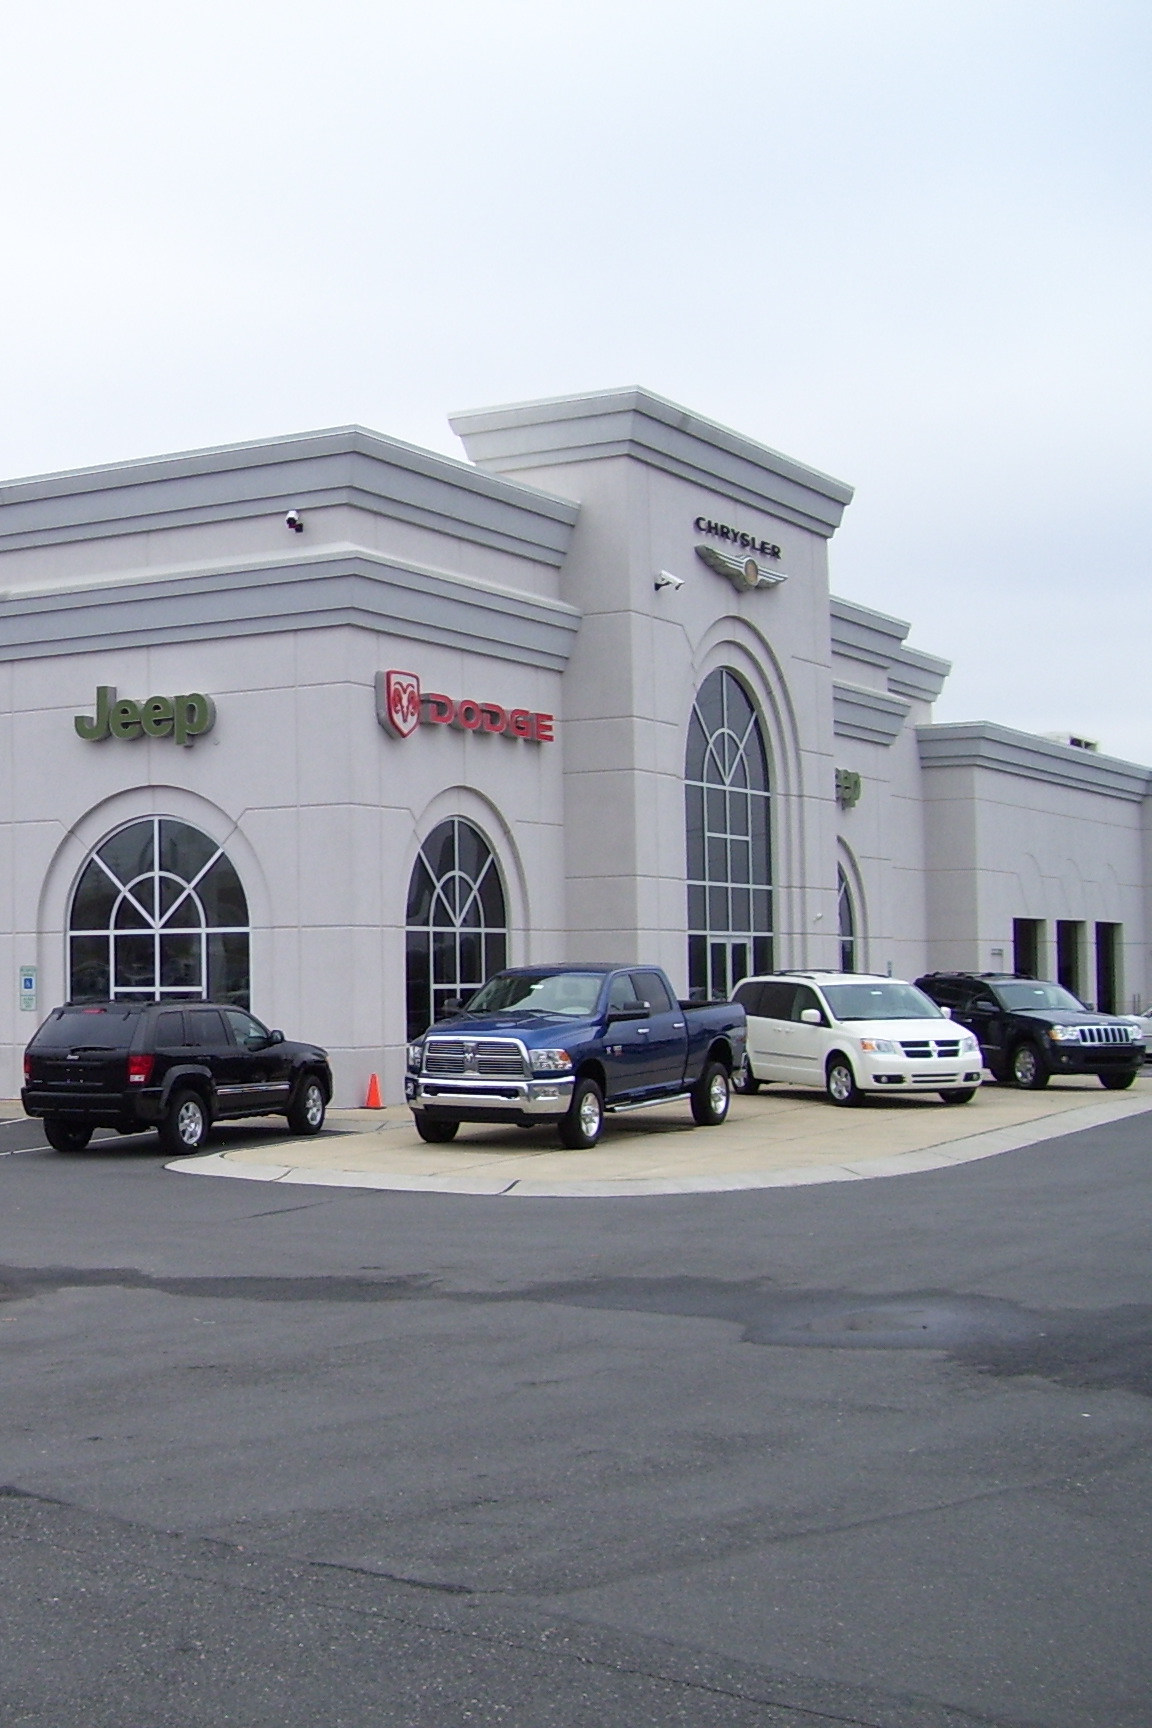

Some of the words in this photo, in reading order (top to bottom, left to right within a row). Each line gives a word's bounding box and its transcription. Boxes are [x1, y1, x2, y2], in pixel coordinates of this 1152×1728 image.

[695, 517, 781, 559] CHRYSLER
[74, 686, 216, 747] Jeep
[423, 692, 554, 743] DODGE
